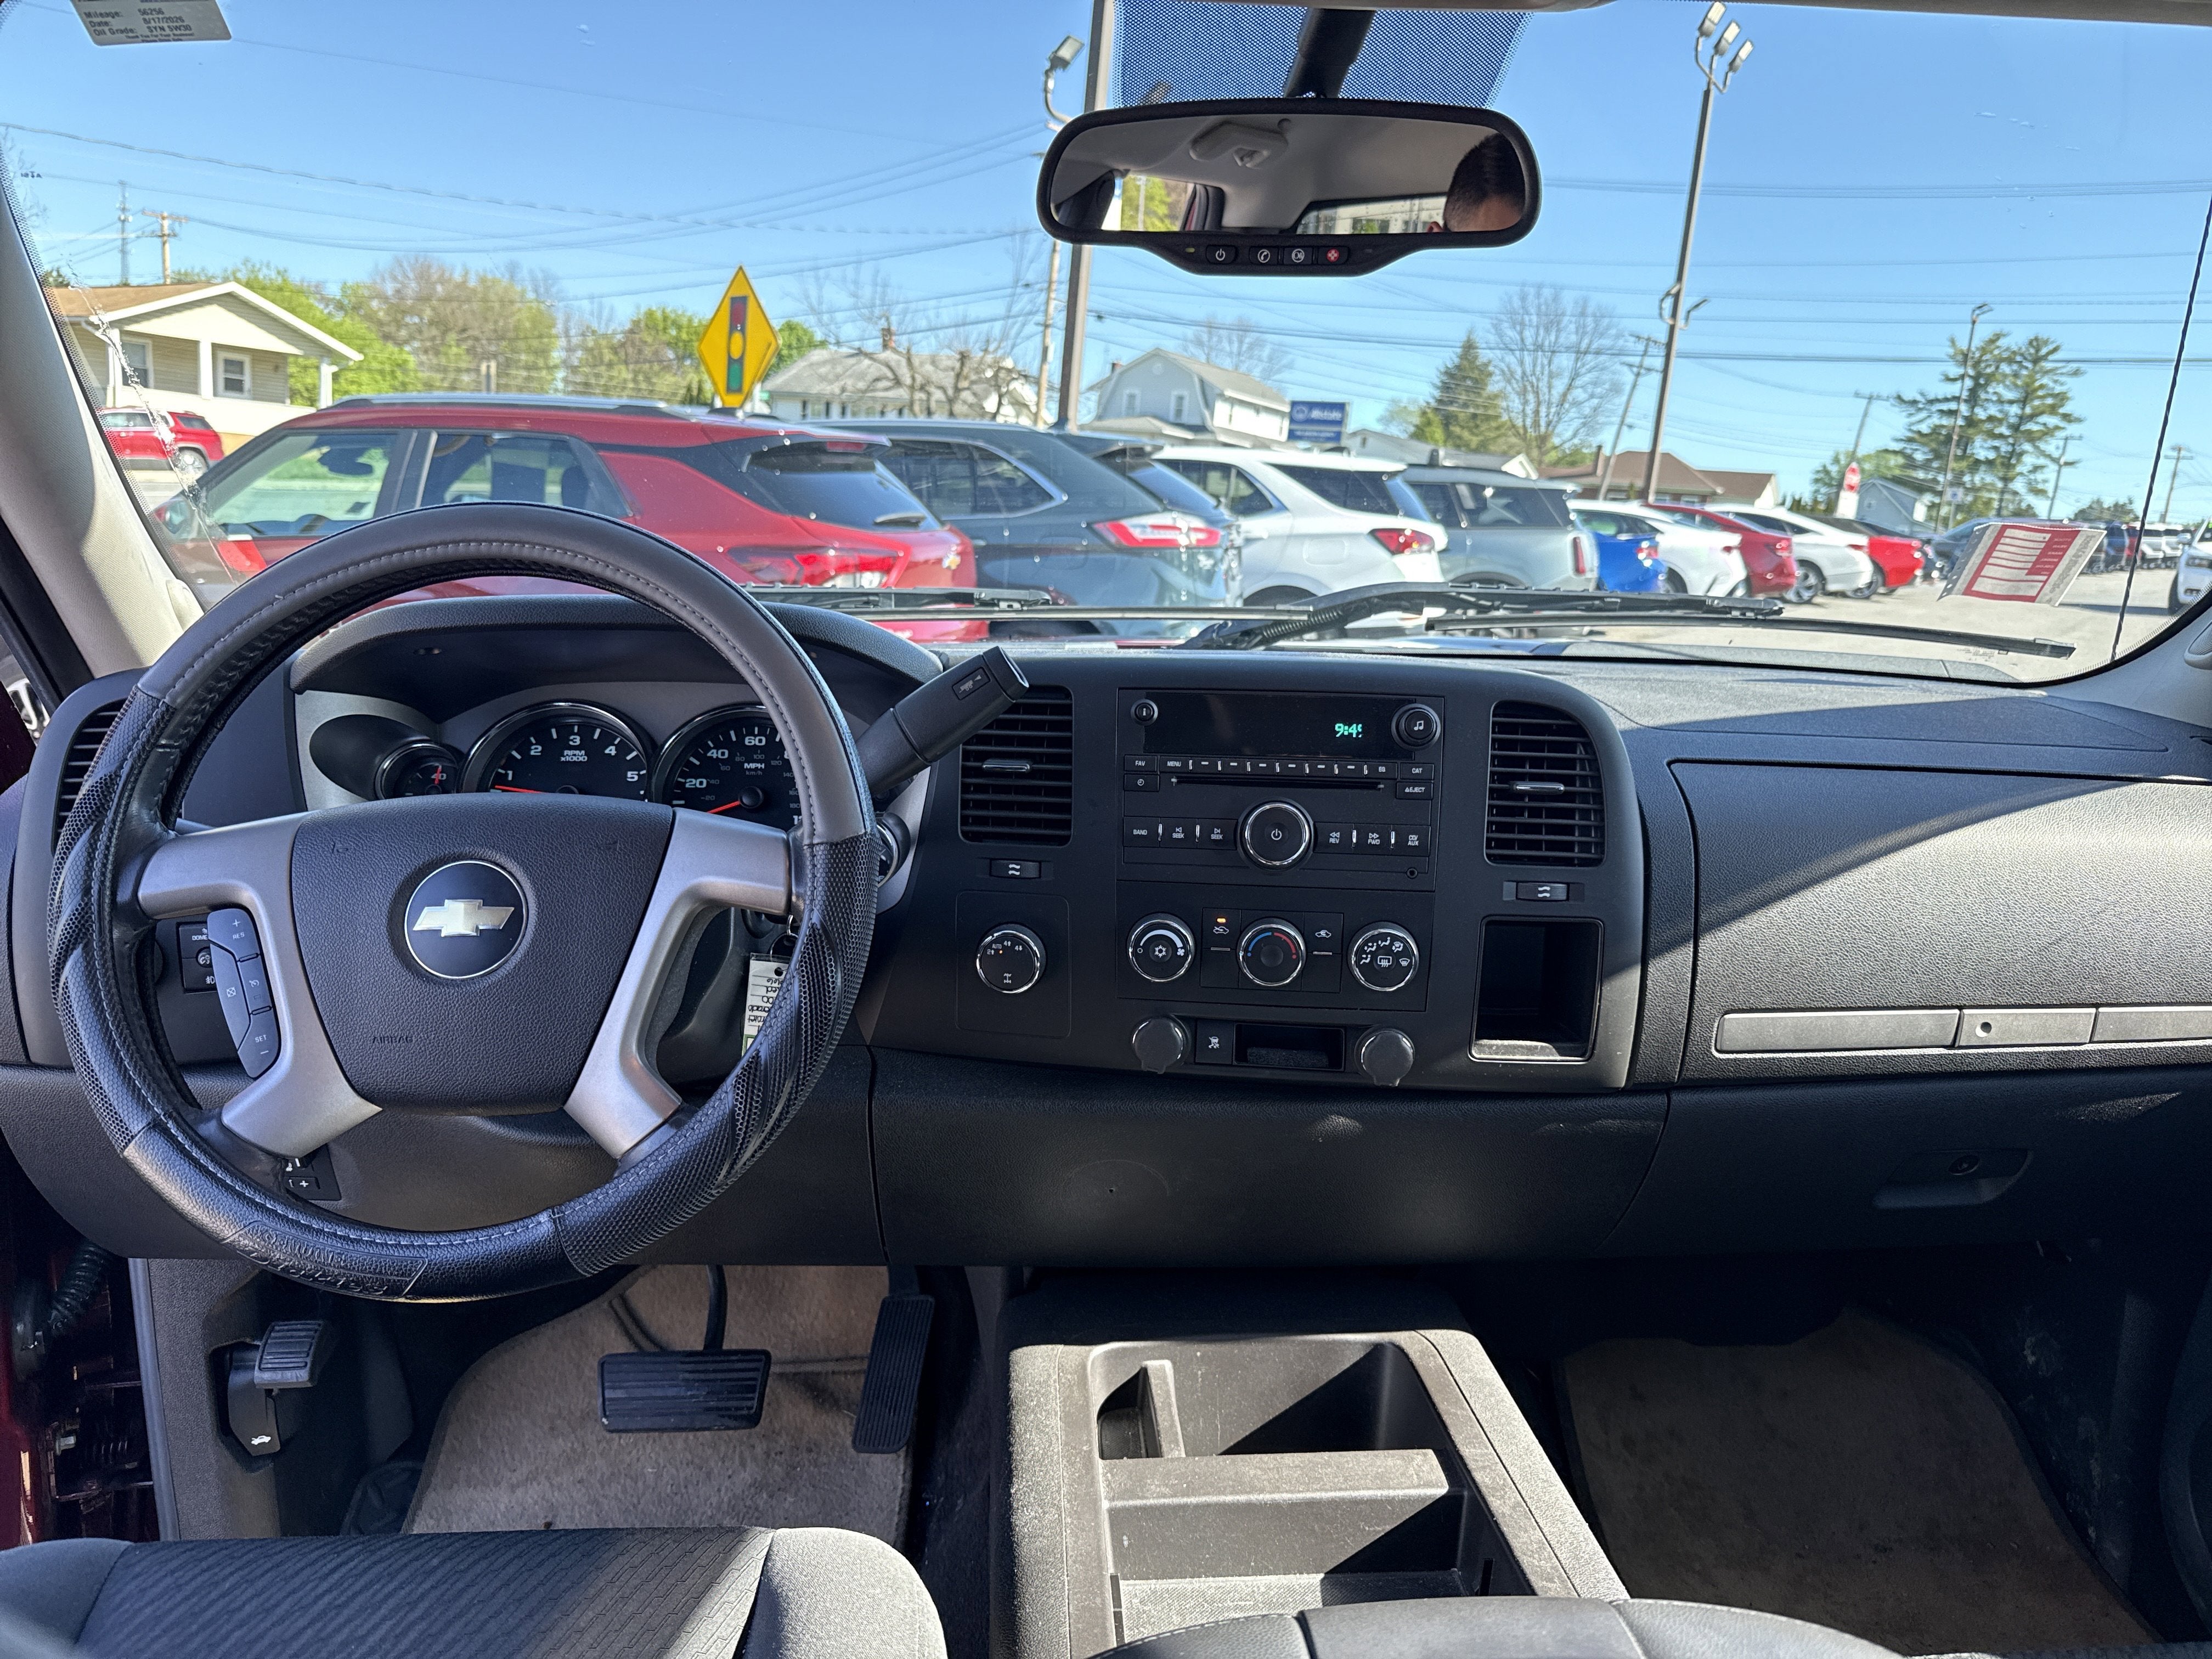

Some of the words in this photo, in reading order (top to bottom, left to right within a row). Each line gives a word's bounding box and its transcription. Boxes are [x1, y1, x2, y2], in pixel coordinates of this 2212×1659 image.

[138, 7, 165, 16] 56256
[142, 16, 185, 25] 8/17/2026
[93, 28, 107, 36] Oil
[108, 27, 137, 35] Grade:
[146, 25, 166, 33] SYN
[569, 735, 580, 745] 3
[744, 736, 766, 746] 60
[531, 745, 542, 755] 2
[605, 746, 617, 756] 4
[707, 749, 729, 759] 40
[506, 770, 513, 781] 1
[627, 771, 639, 782] 5
[685, 778, 707, 788] 20
[232, 932, 245, 940] RES
[255, 1034, 267, 1043] SET
